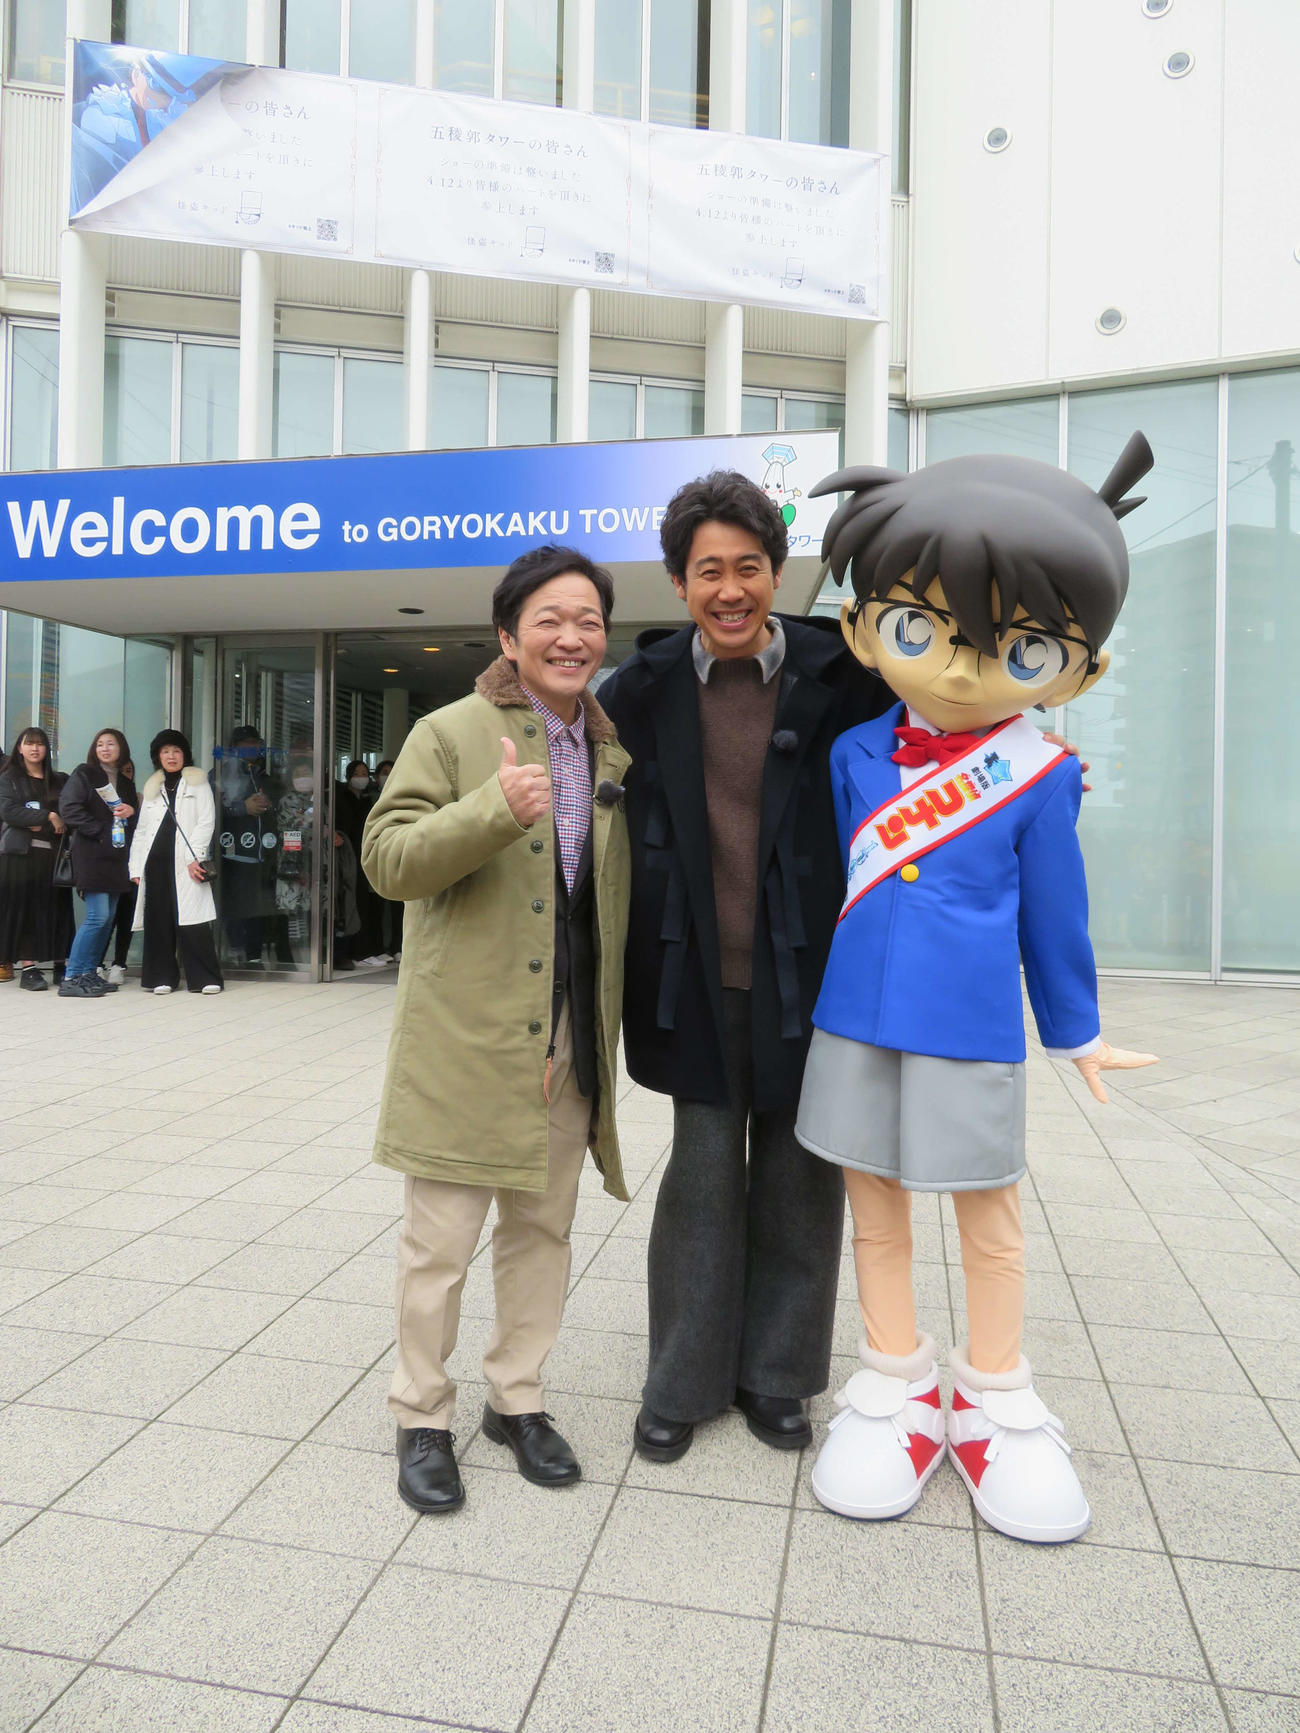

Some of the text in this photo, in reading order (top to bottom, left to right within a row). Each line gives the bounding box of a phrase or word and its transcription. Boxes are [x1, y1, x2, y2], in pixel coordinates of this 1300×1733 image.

[227, 100, 312, 120] ーの皆さん
[431, 125, 590, 159] 五稜郭タワーの皆さん
[697, 163, 842, 196] 五稜郭タワーの皆さん
[7, 496, 664, 559] Welcome to GORYOKAKU TOWE
